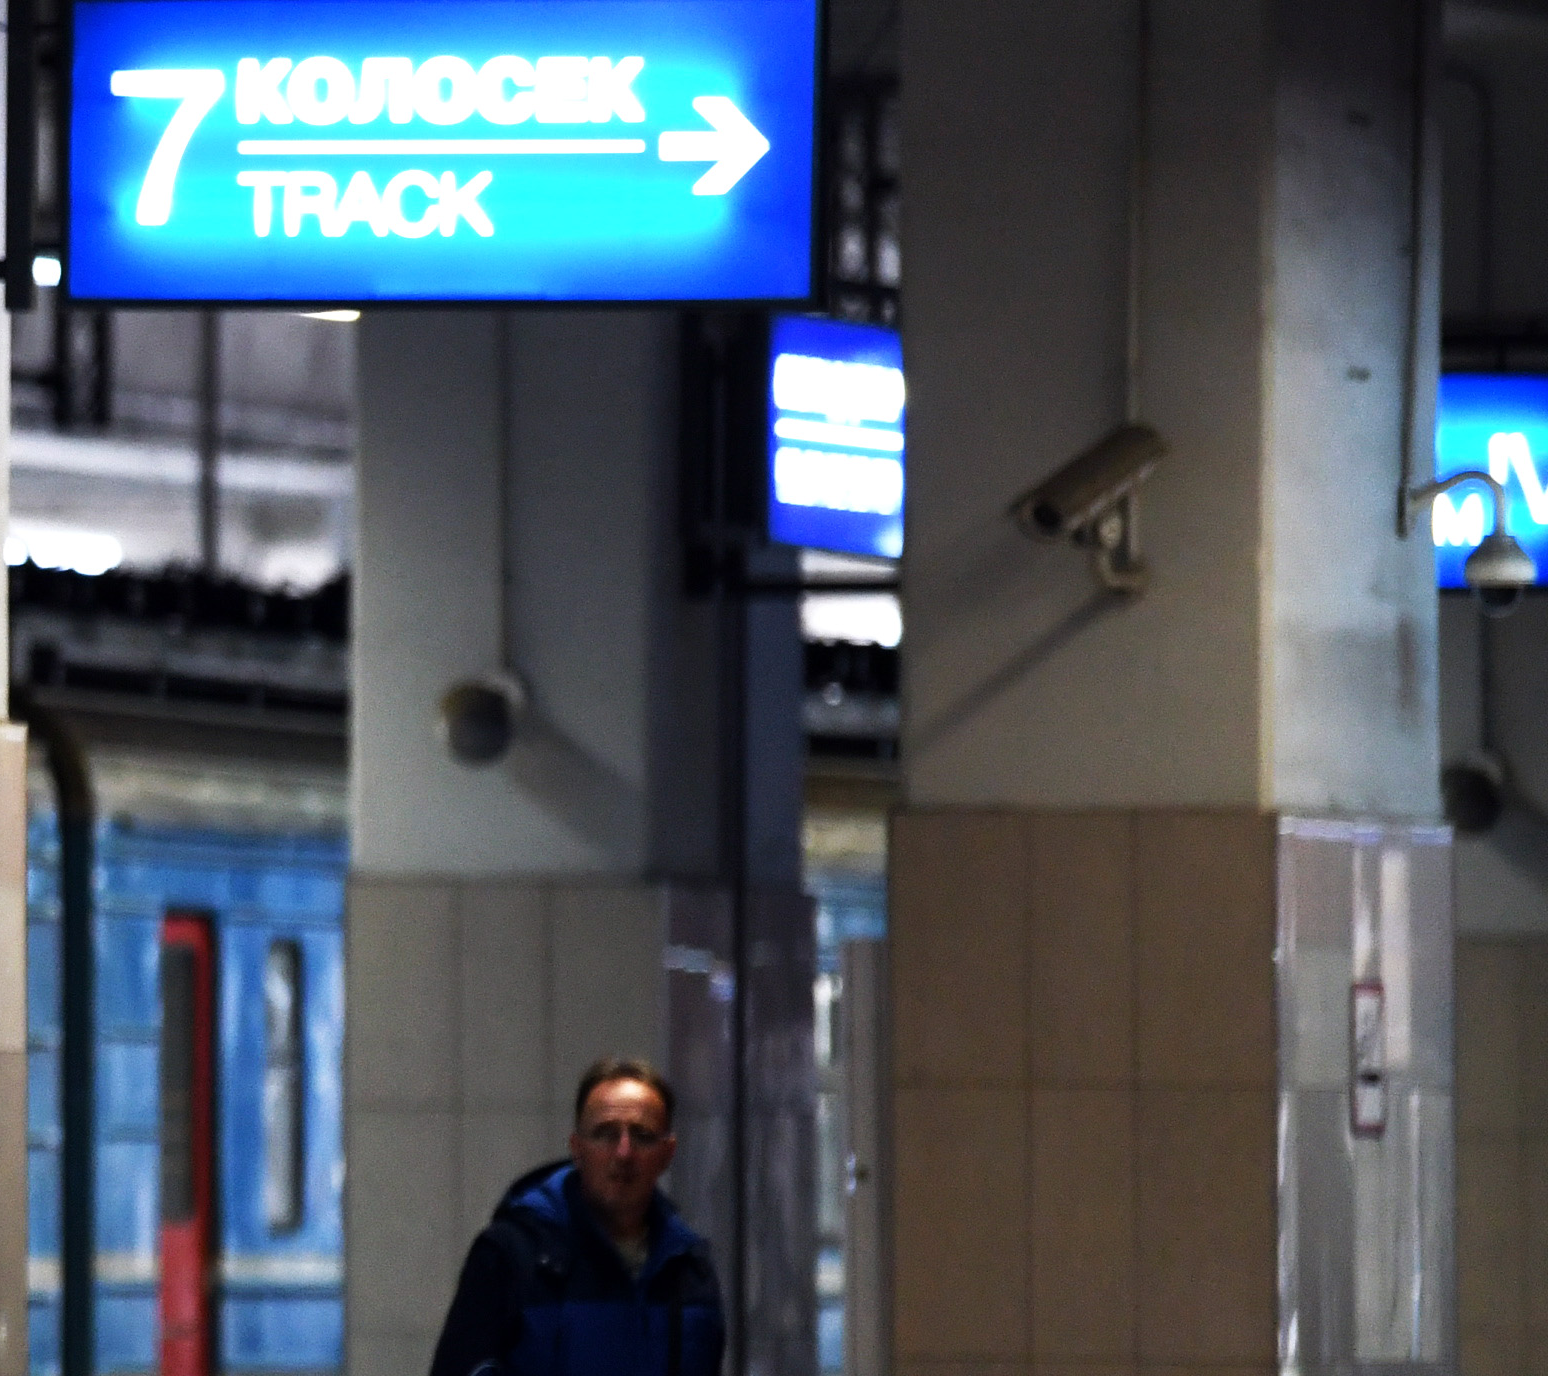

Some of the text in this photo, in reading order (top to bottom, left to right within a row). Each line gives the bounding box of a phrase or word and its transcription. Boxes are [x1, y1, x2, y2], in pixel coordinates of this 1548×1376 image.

[234, 53, 647, 127] КОЛОСЕК
[110, 68, 226, 227] 7
[236, 169, 495, 238] TRACK
